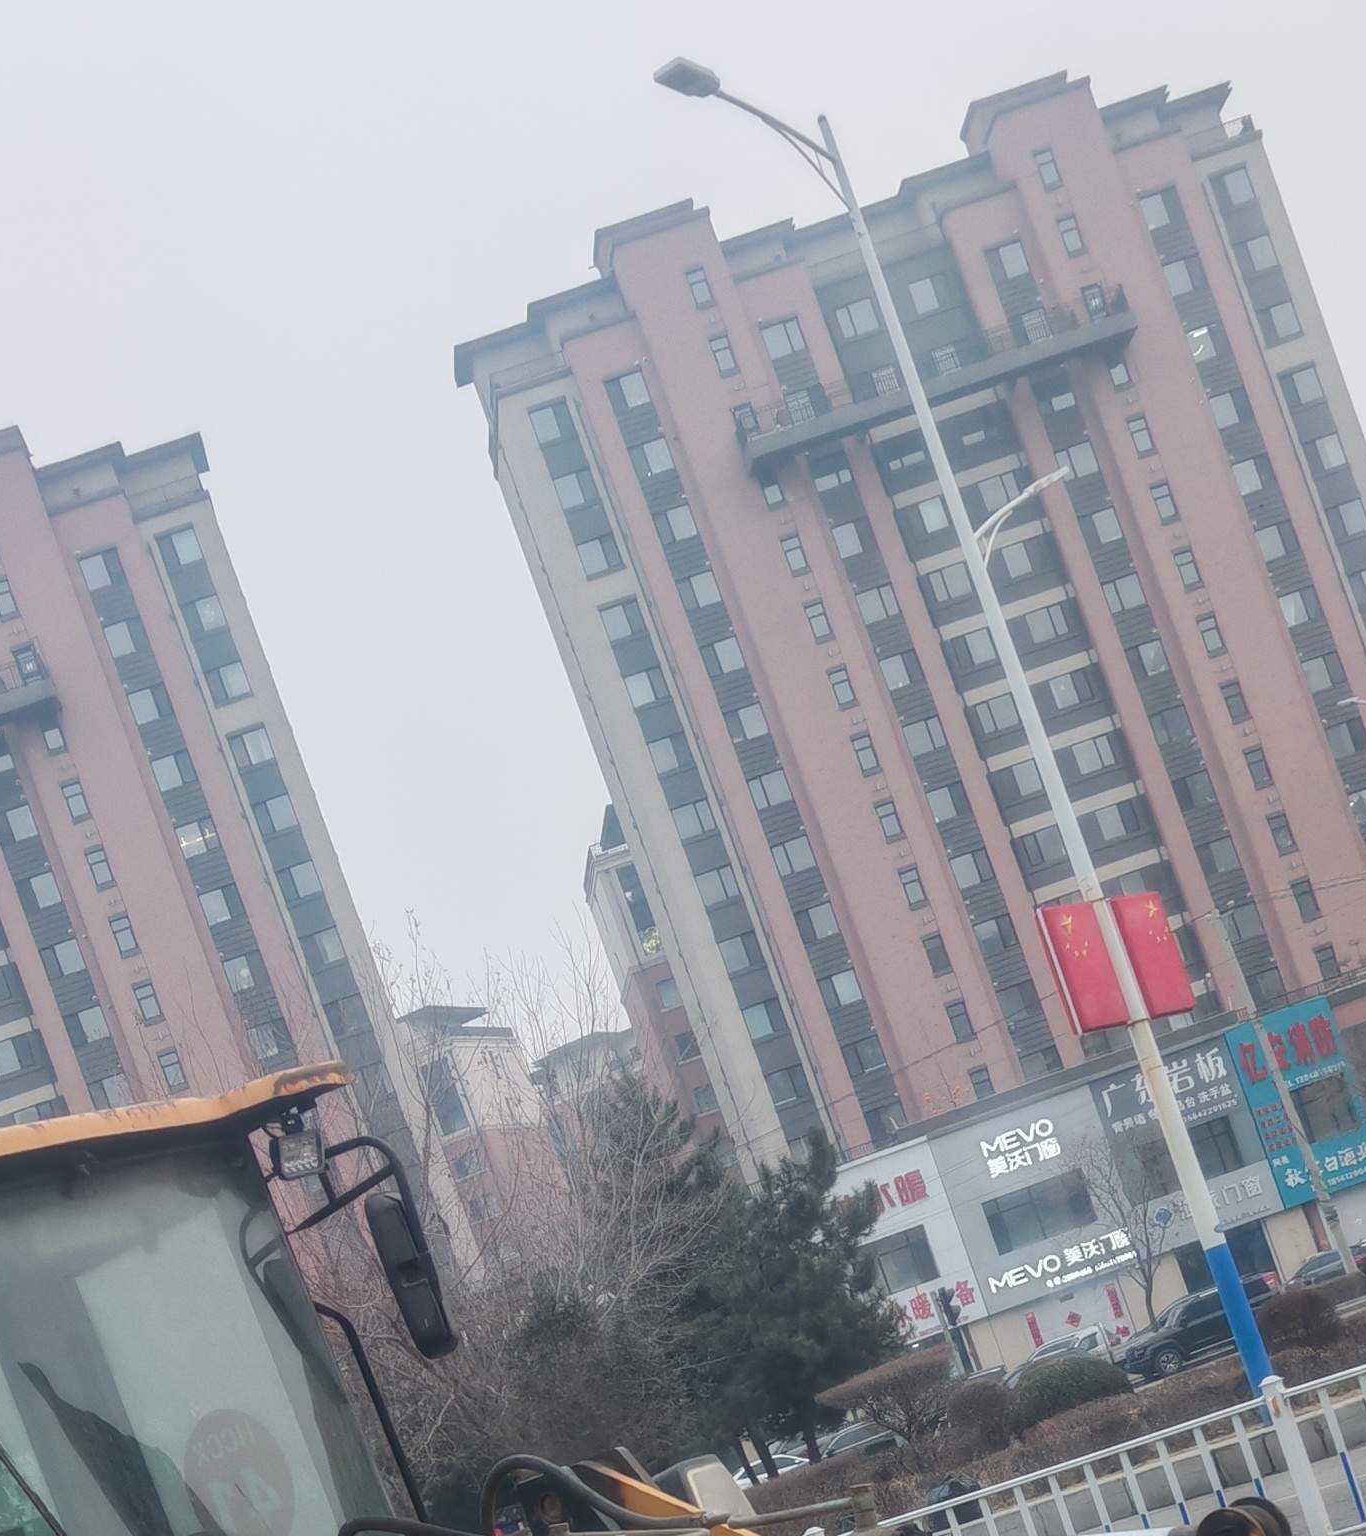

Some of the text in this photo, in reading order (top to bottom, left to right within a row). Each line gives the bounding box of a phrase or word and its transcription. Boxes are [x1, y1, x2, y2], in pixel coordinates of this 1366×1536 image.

[979, 1118, 1054, 1158] MEVO
[986, 1137, 1062, 1179] 美沃门窗
[988, 1254, 1061, 1294] MEVO
[1063, 1226, 1132, 1267] 美沃门窗
[893, 1280, 976, 1328] 水暖备
